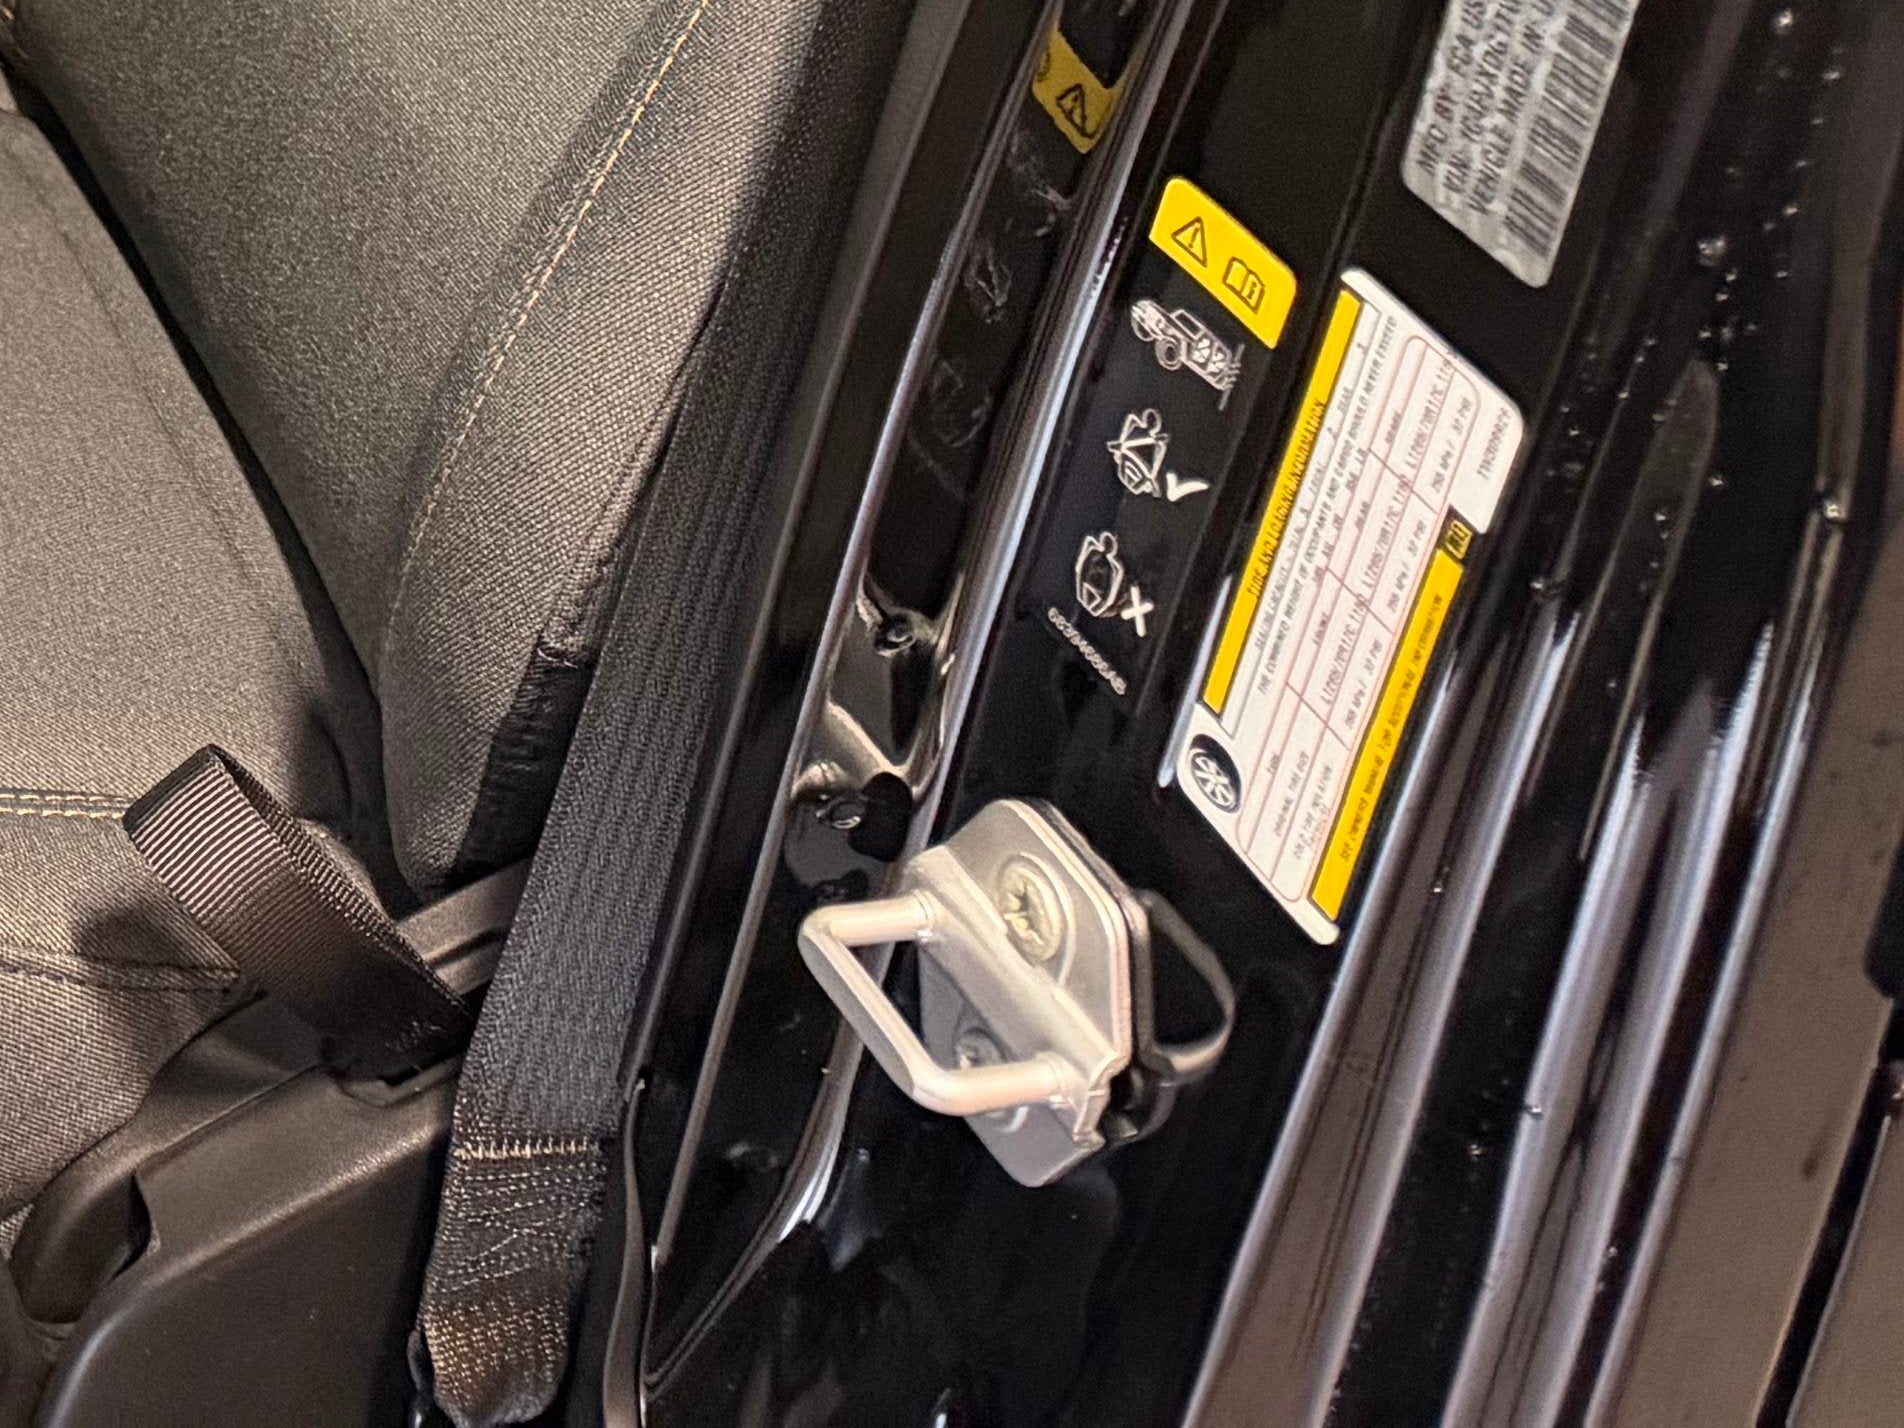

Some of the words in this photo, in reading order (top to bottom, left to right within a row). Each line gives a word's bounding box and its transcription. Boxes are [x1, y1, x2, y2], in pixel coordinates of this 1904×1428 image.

[1445, 28, 1476, 81] FCA
[1465, 118, 1514, 222] VEHICLE
[1495, 50, 1535, 126] MADE
[1257, 536, 1276, 571] AND
[1285, 392, 1326, 489] INFORMATION
